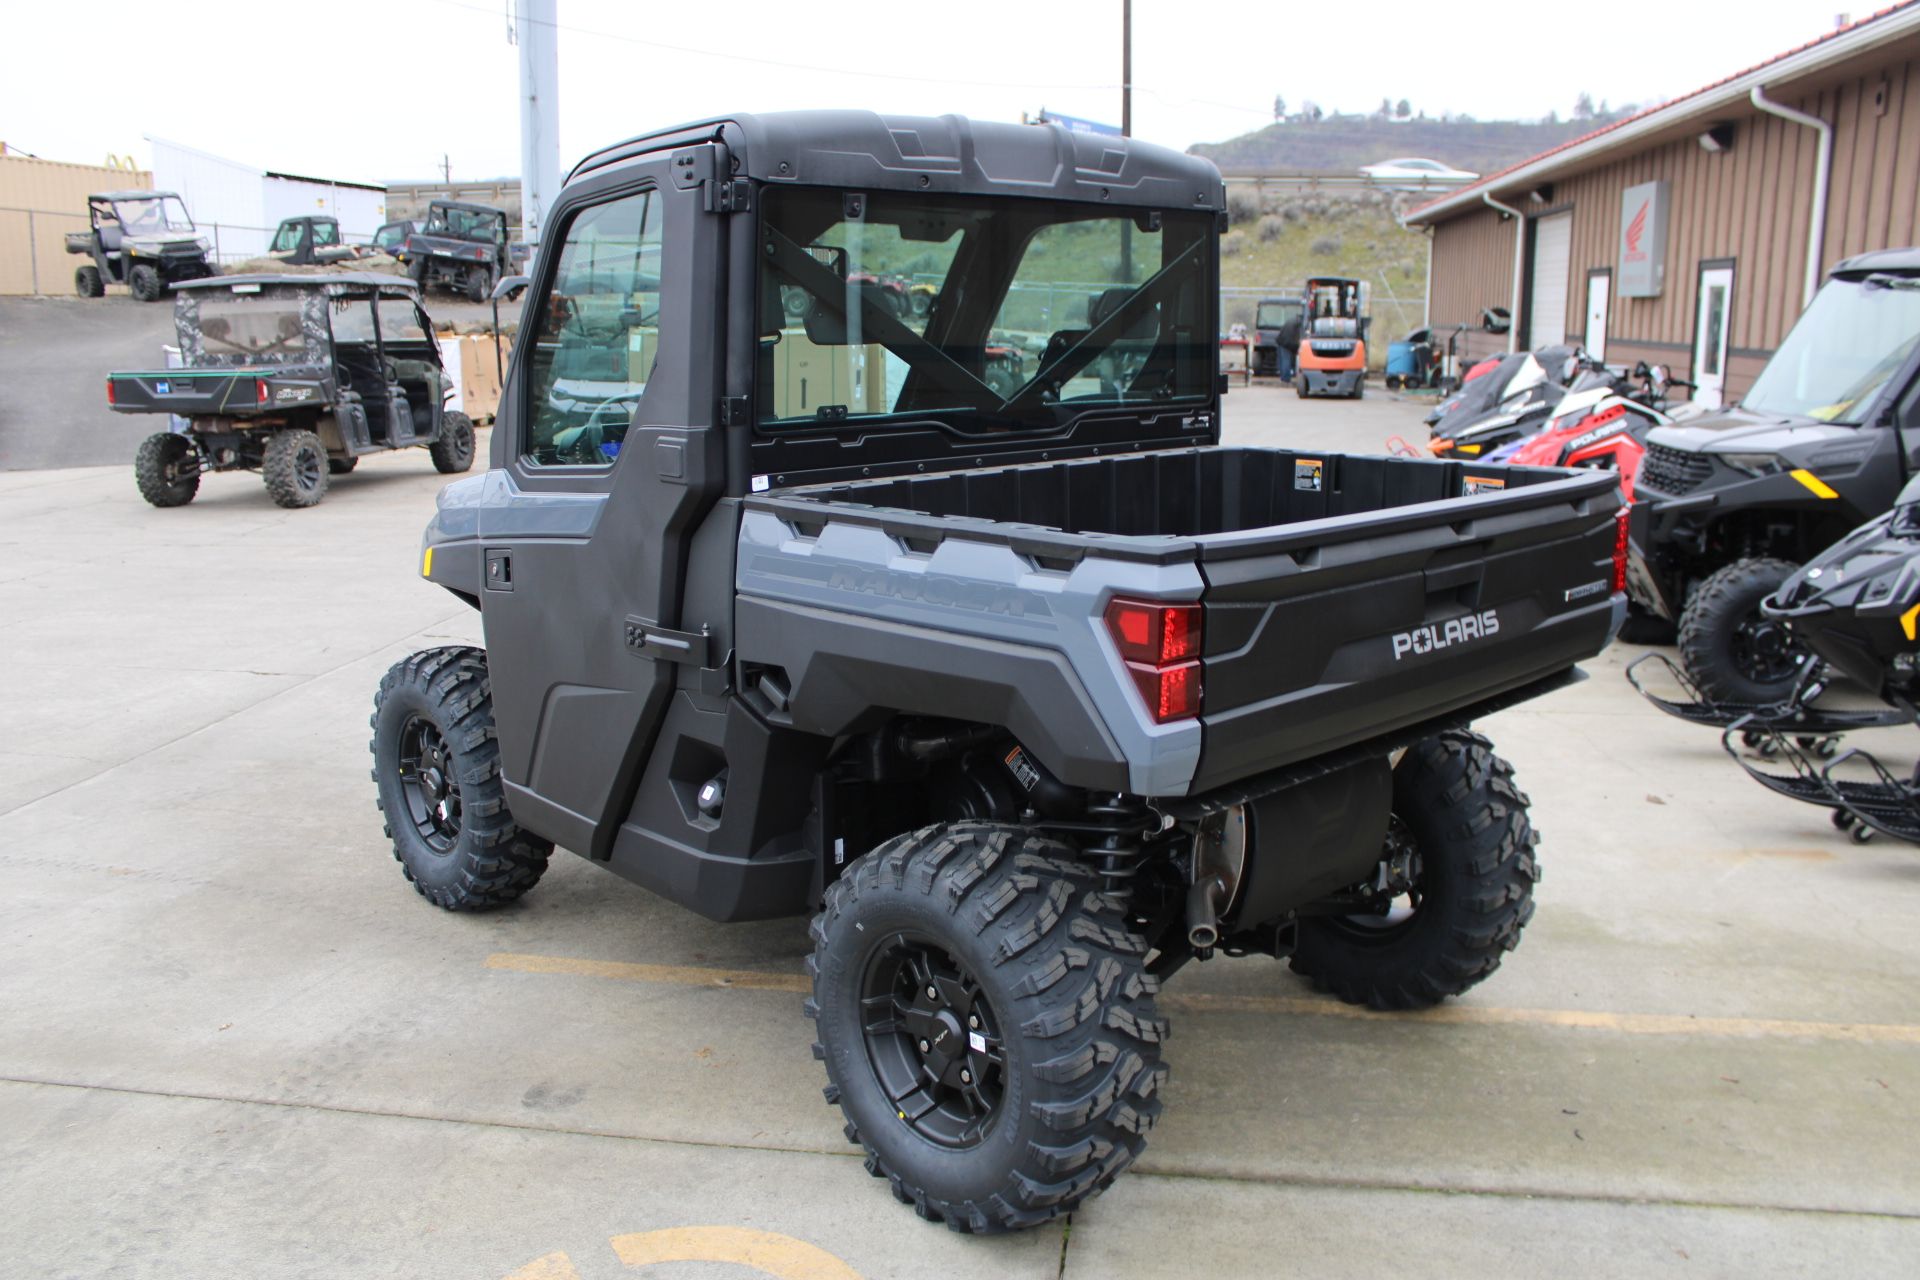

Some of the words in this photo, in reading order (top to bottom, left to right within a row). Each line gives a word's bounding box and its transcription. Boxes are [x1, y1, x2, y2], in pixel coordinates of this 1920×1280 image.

[1570, 418, 1628, 449] POLARIS
[826, 565, 1026, 618] RANGER
[1392, 609, 1499, 660] POLARIS
